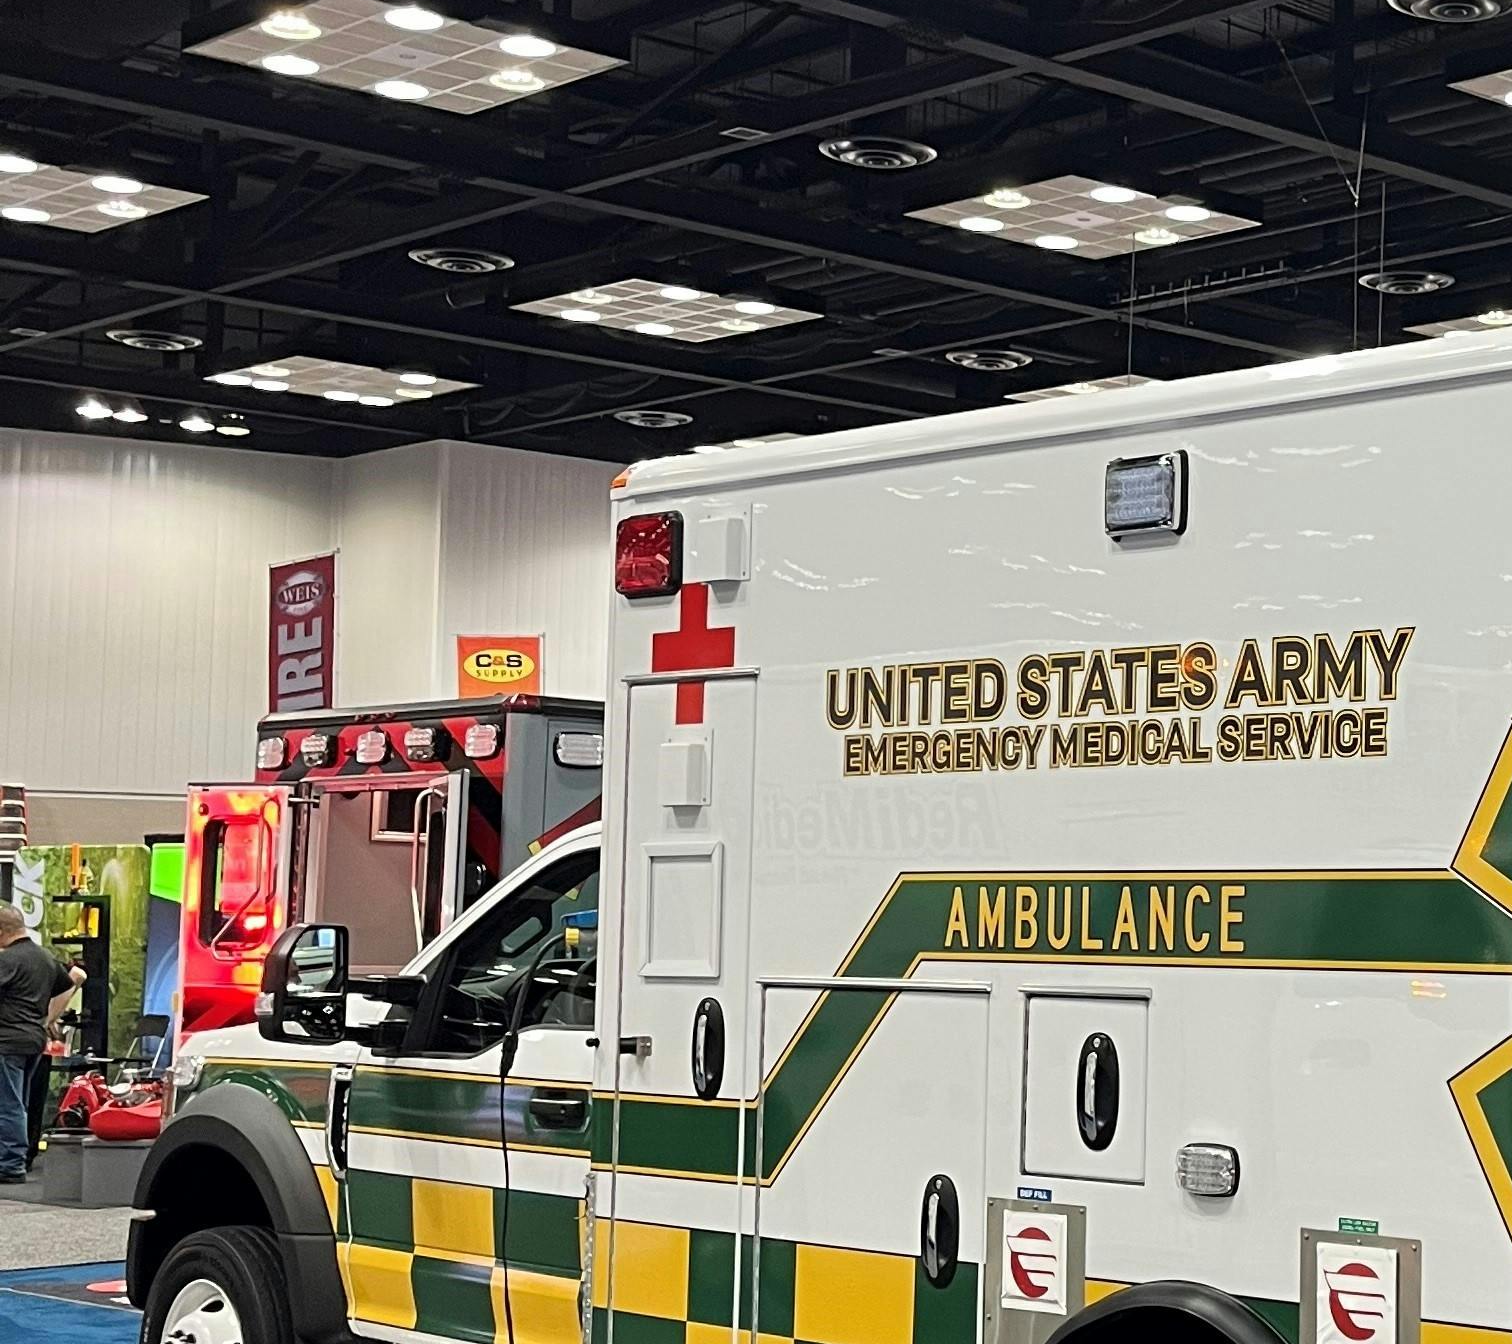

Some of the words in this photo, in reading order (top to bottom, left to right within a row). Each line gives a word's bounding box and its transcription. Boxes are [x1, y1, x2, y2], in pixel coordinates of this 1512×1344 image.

[281, 582, 321, 604] WEIS
[277, 615, 325, 713] IRE
[475, 653, 523, 668] C&S
[475, 669, 523, 678] SUPPLY
[824, 657, 1008, 732] UNITED
[1016, 640, 1218, 721] STATES
[1223, 625, 1417, 710] ARMY
[842, 723, 1048, 778] EMERGENCY
[1049, 718, 1213, 769] MEDICAL
[1216, 708, 1389, 762] SERVICE
[943, 883, 1247, 953] AMBULANCE
